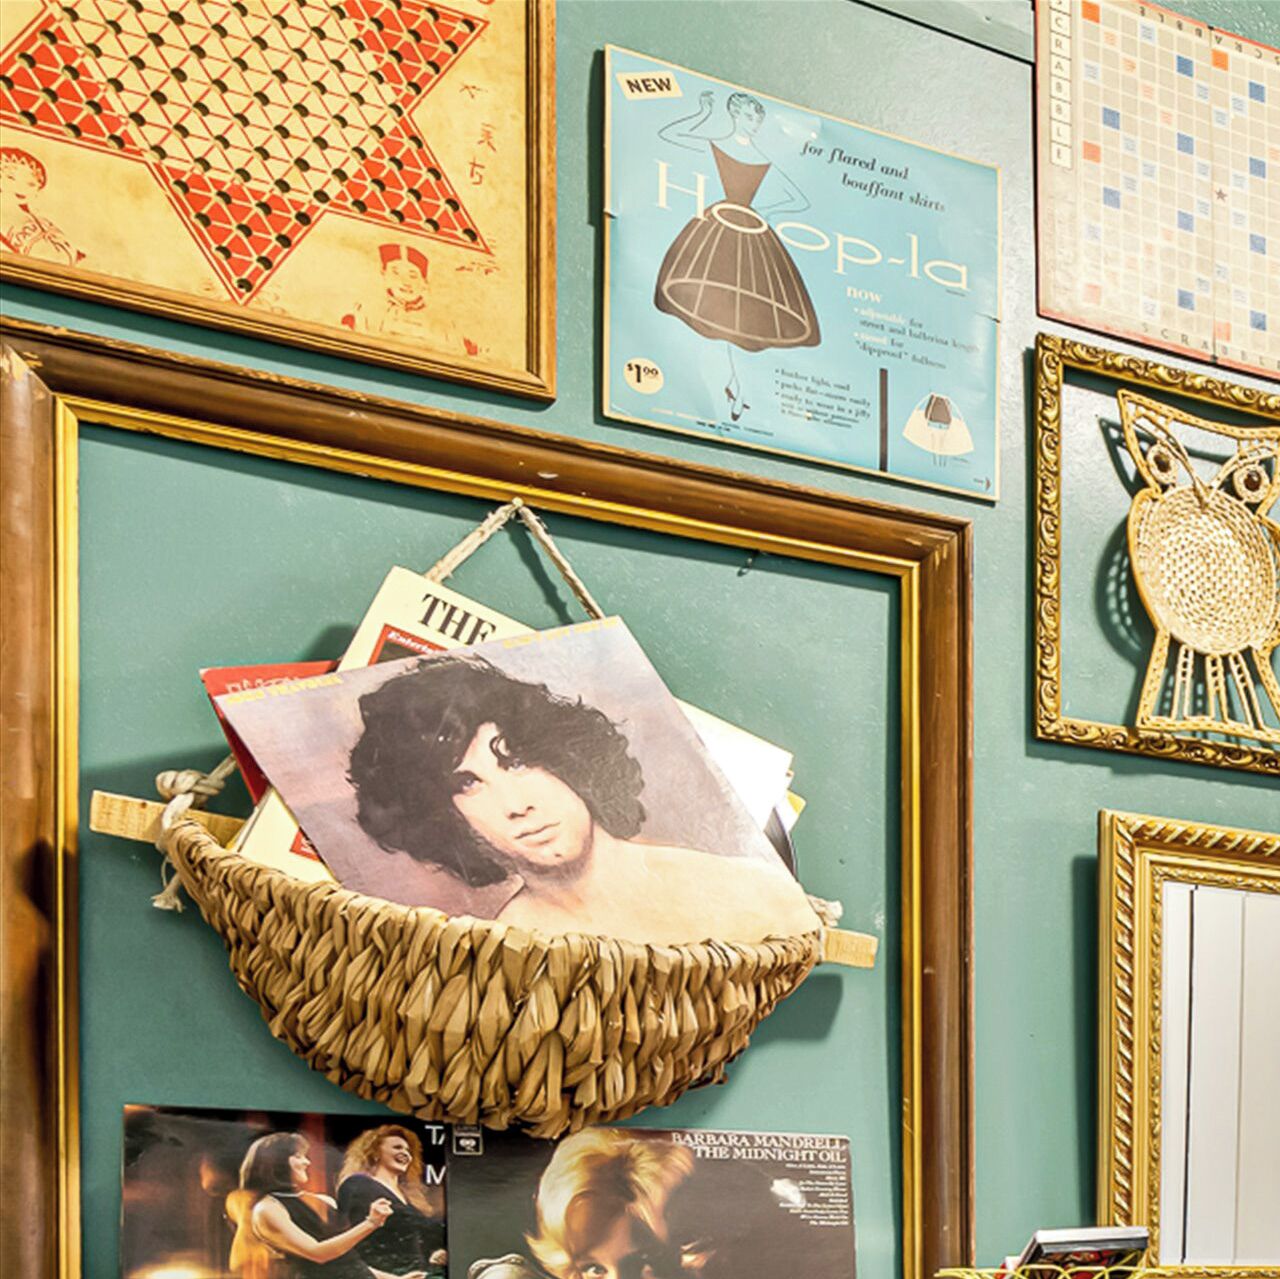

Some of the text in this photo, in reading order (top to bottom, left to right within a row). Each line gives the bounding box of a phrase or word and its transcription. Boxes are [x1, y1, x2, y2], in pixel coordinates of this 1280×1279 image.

[626, 75, 673, 95] NEW
[800, 141, 909, 180] for flared and
[842, 172, 945, 211] bouffant skirts
[846, 285, 881, 303] now
[417, 594, 496, 646] THE
[672, 1131, 847, 1150] BARBARA MANDRELL
[692, 1145, 847, 1163] THE MIDNIGHT OIL
